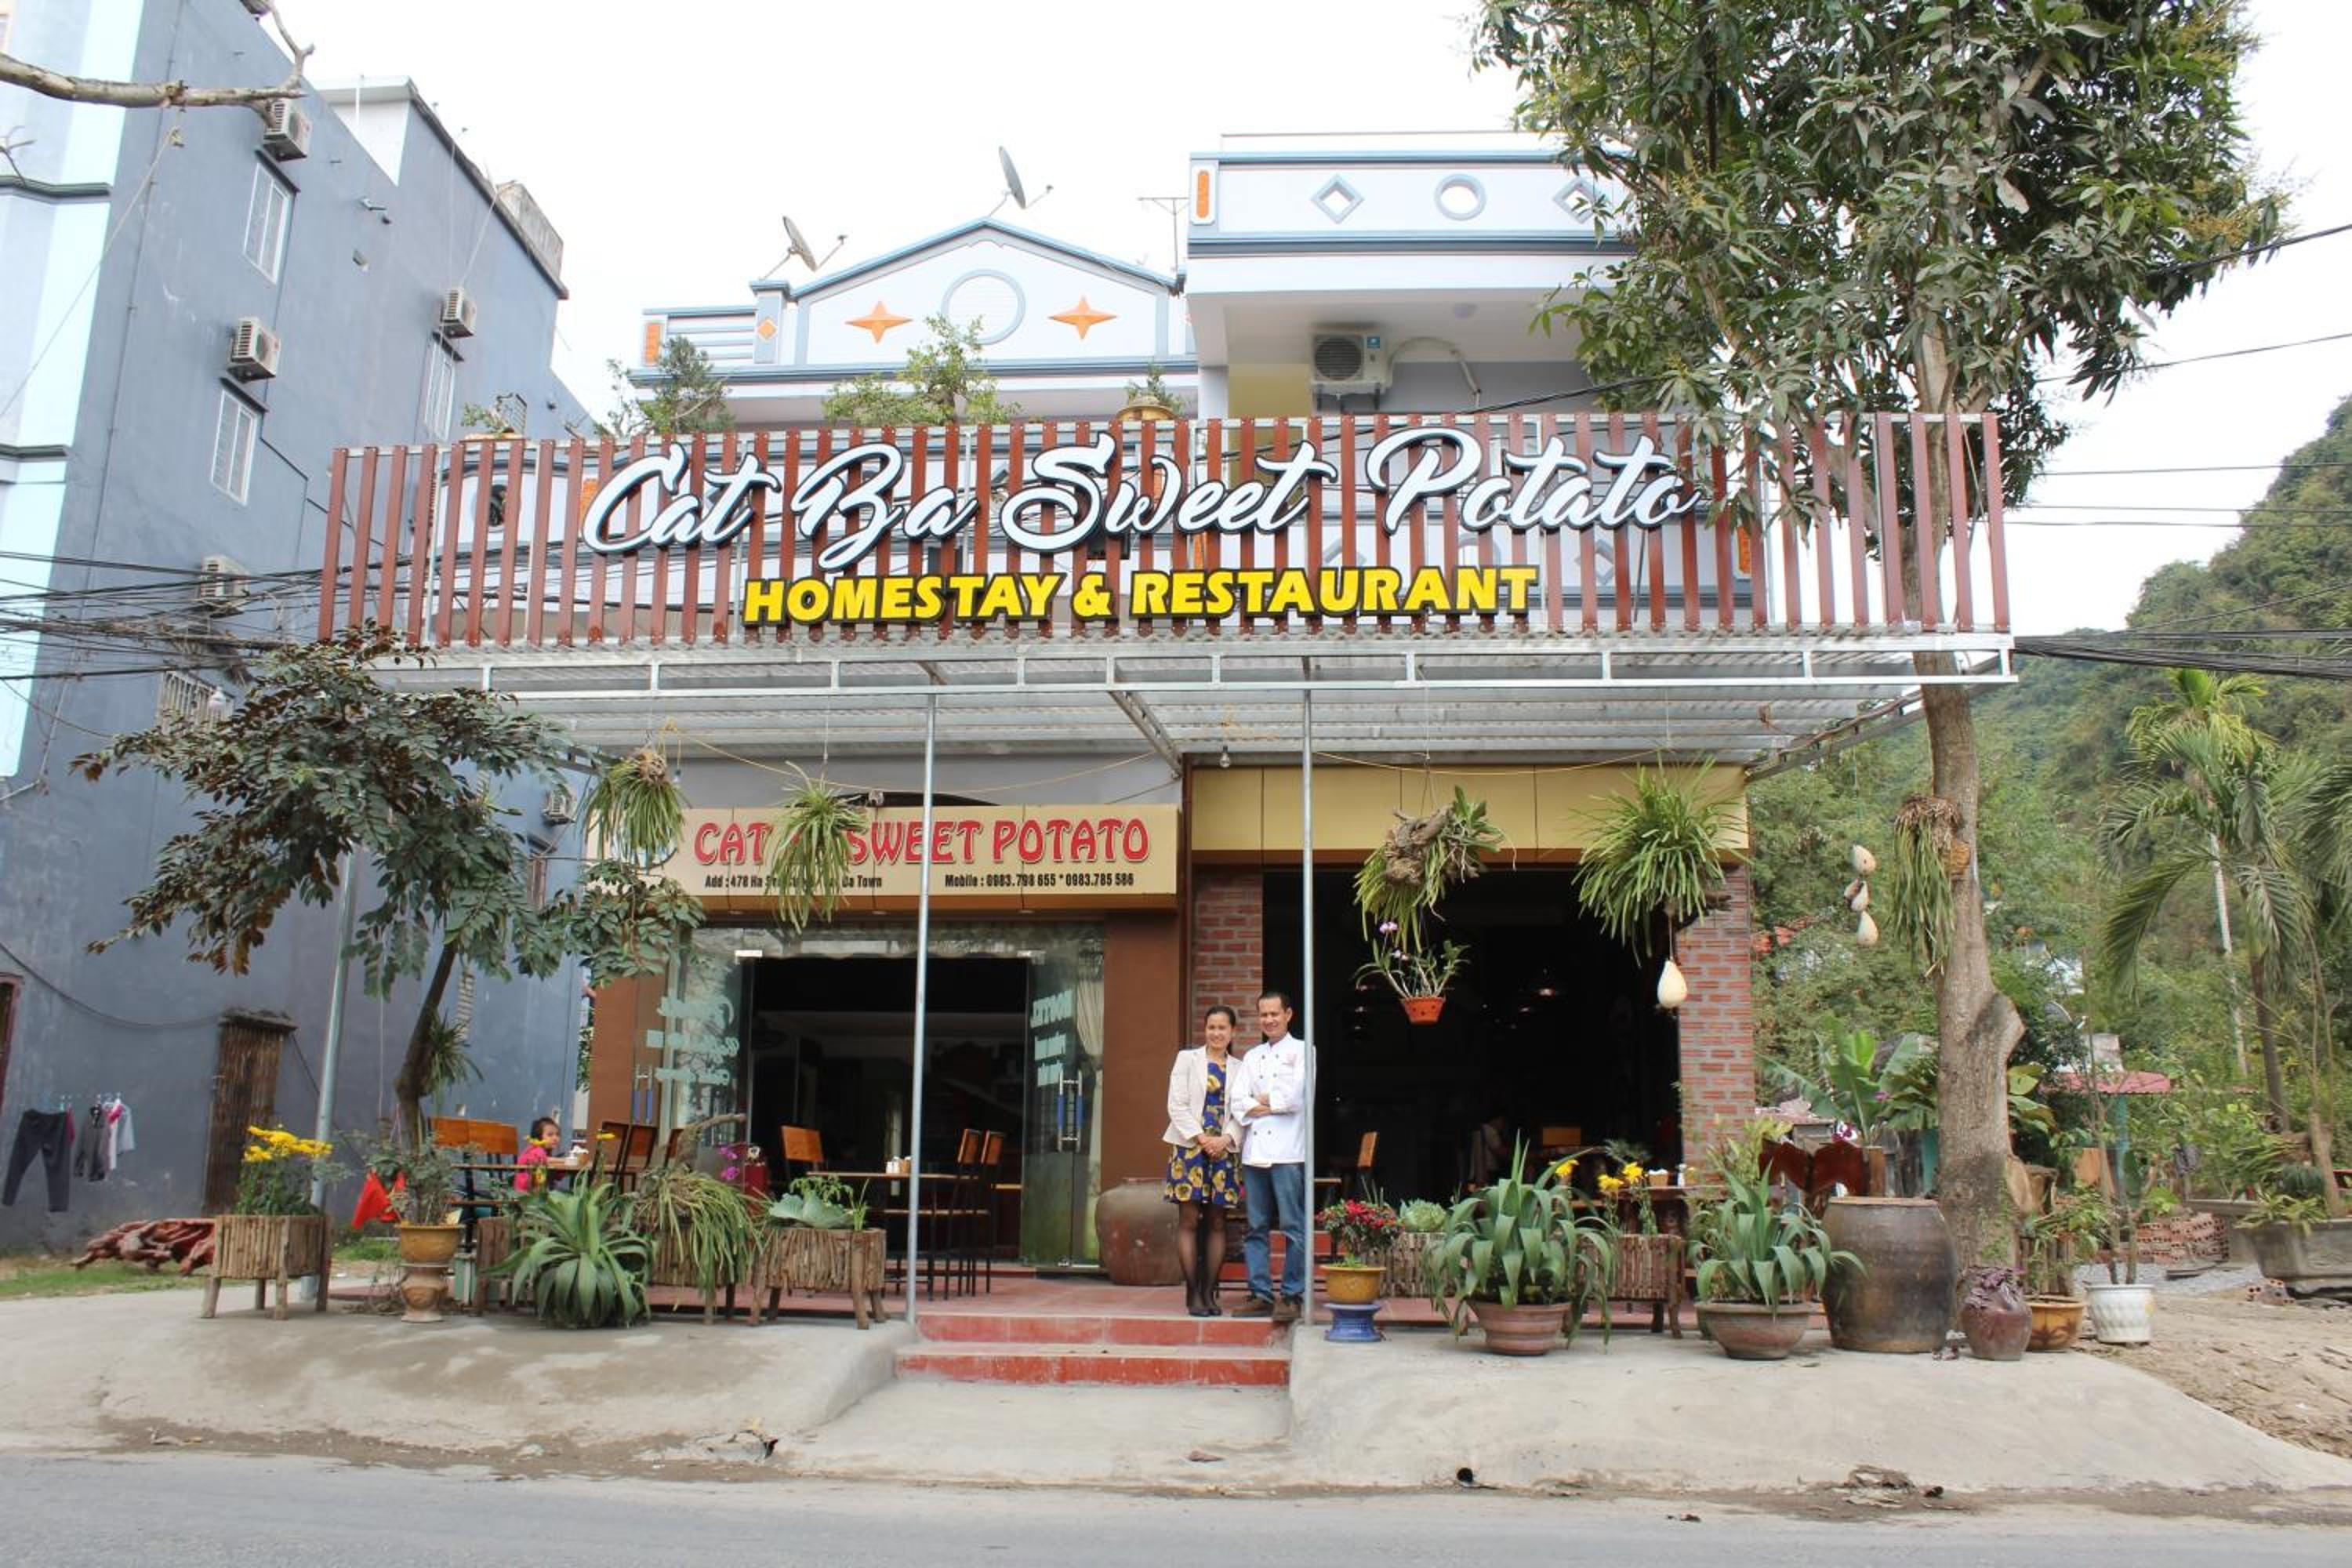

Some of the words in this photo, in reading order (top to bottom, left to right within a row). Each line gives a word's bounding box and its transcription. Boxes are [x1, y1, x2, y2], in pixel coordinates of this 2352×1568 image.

[582, 442, 782, 552] Cat
[790, 441, 980, 571] Ba
[1000, 432, 1338, 552] Sweet
[1366, 426, 1701, 536] Potato
[742, 572, 1066, 625] HOMESTAY
[1070, 572, 1112, 622] &
[1130, 564, 1540, 620] RESTAURANT
[694, 822, 771, 865] CAT
[847, 819, 982, 865] SWEET
[993, 818, 1151, 864] POTATO
[857, 874, 882, 888] Town
[945, 874, 978, 887] Mobile
[1037, 873, 1056, 887] 655
